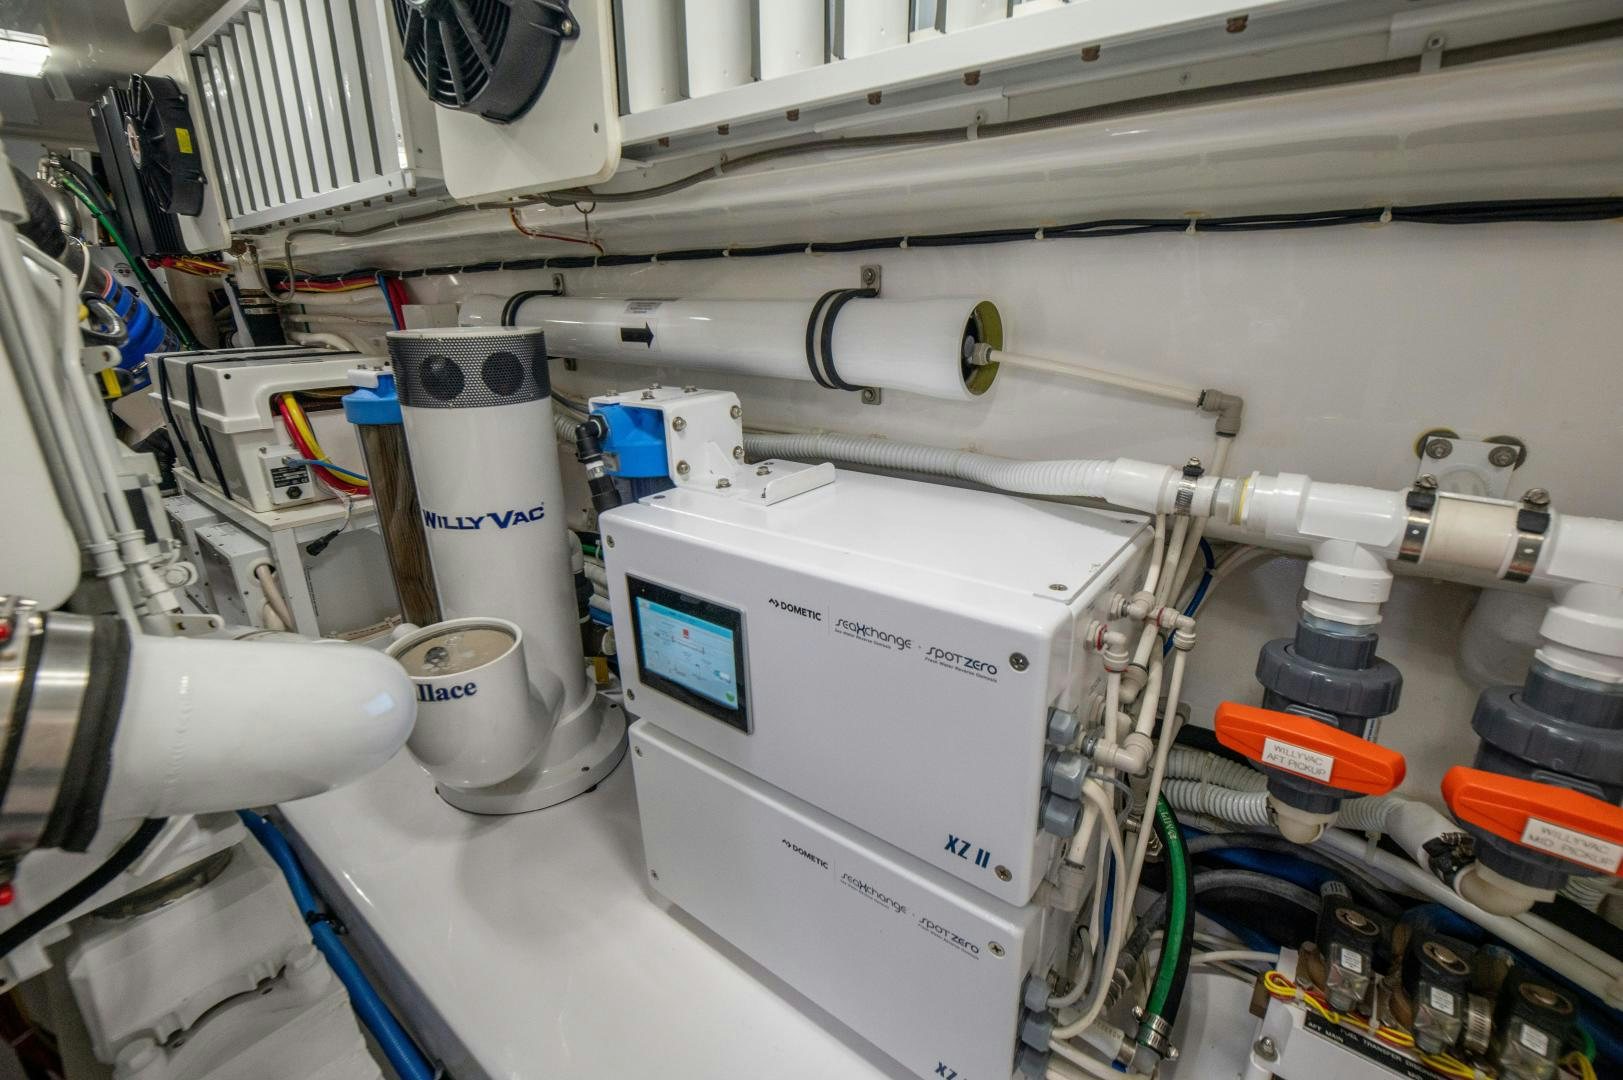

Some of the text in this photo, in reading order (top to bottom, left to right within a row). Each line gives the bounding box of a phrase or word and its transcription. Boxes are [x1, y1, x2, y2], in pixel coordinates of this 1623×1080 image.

[780, 601, 822, 621] DOMETIC
[416, 682, 478, 702] llace
[1266, 752, 1327, 776] AFT PICKUP
[792, 844, 829, 870] DOMETIC
[944, 833, 991, 869] XZ II
